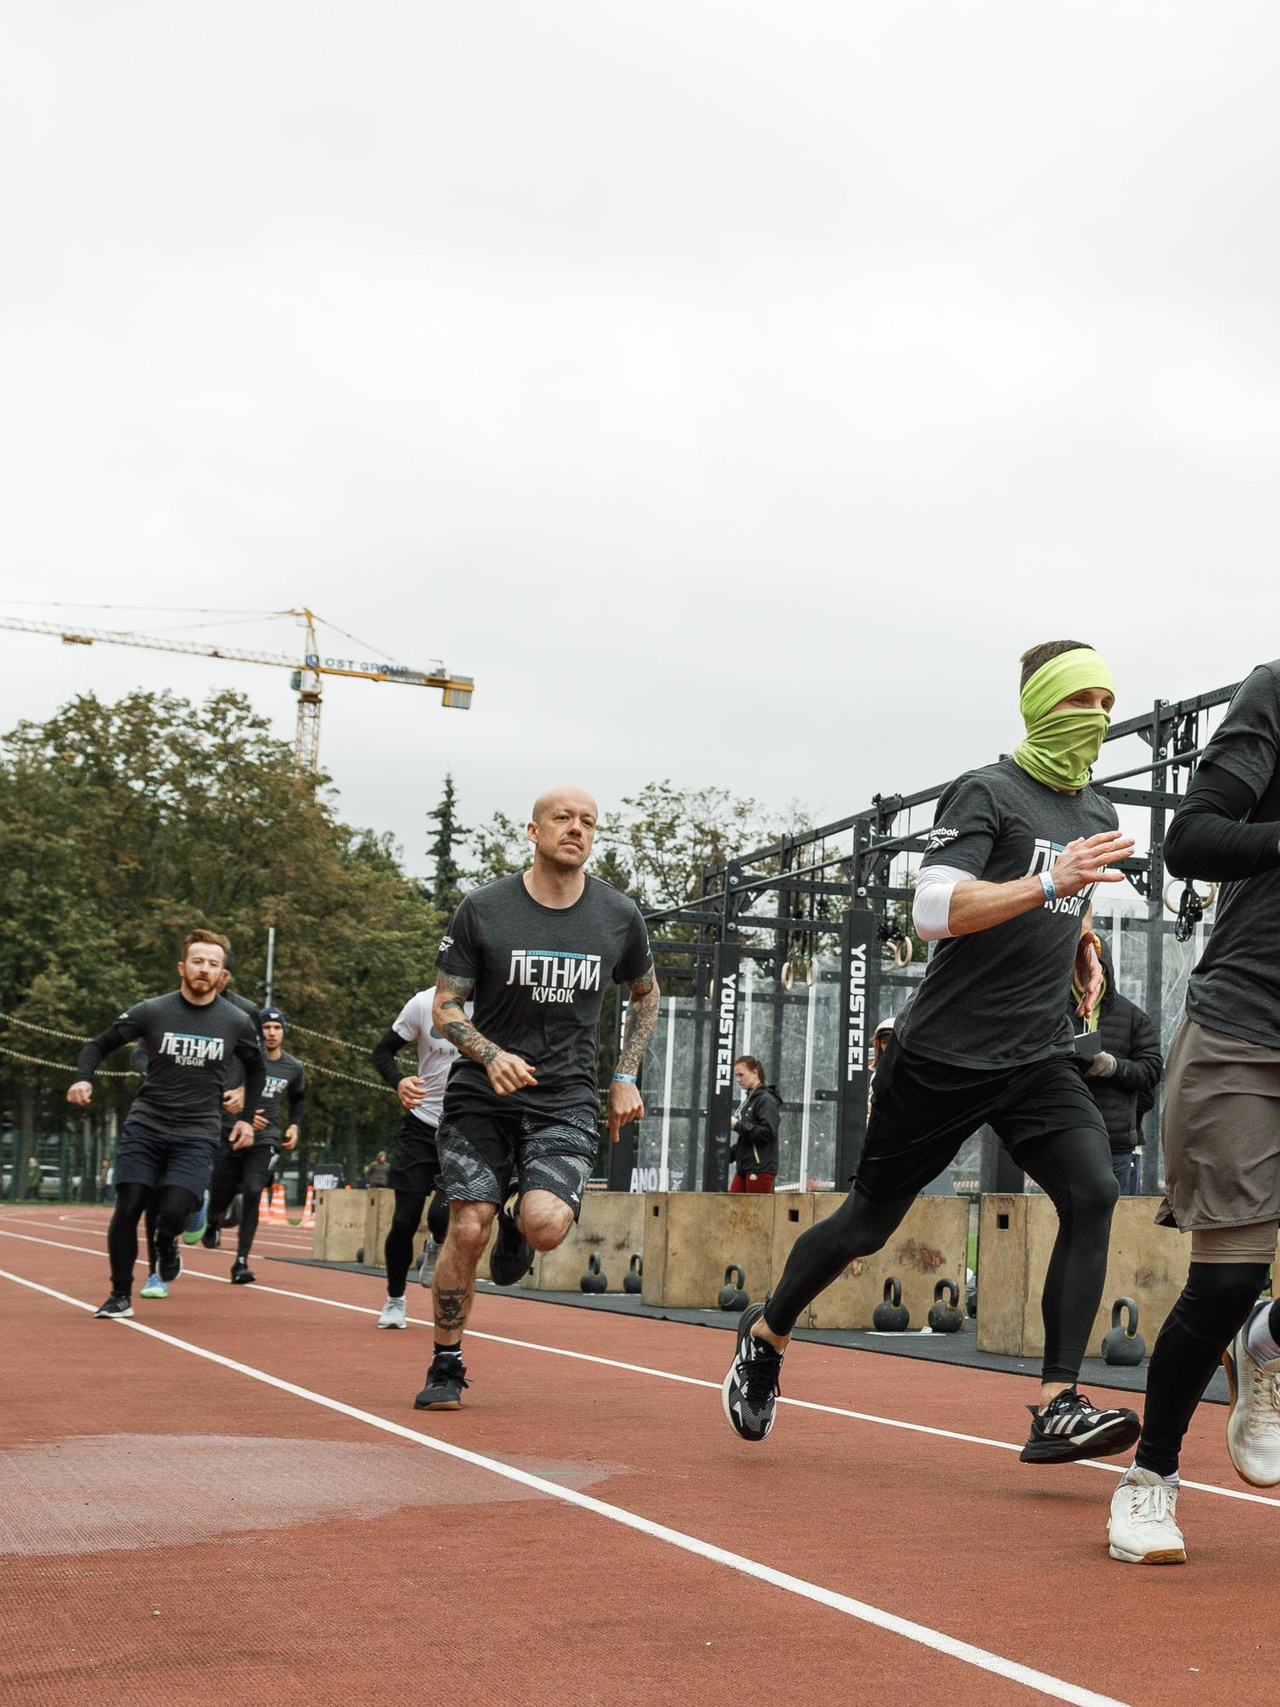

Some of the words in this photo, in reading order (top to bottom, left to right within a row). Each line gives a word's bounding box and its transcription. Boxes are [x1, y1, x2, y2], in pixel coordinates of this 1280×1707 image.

[325, 657, 354, 670] OST
[532, 986, 576, 1004] КУБОК
[847, 943, 867, 1082] YOUSTEEL
[715, 973, 737, 1095] YOUSTEEL
[174, 1053, 206, 1068] КУБОК
